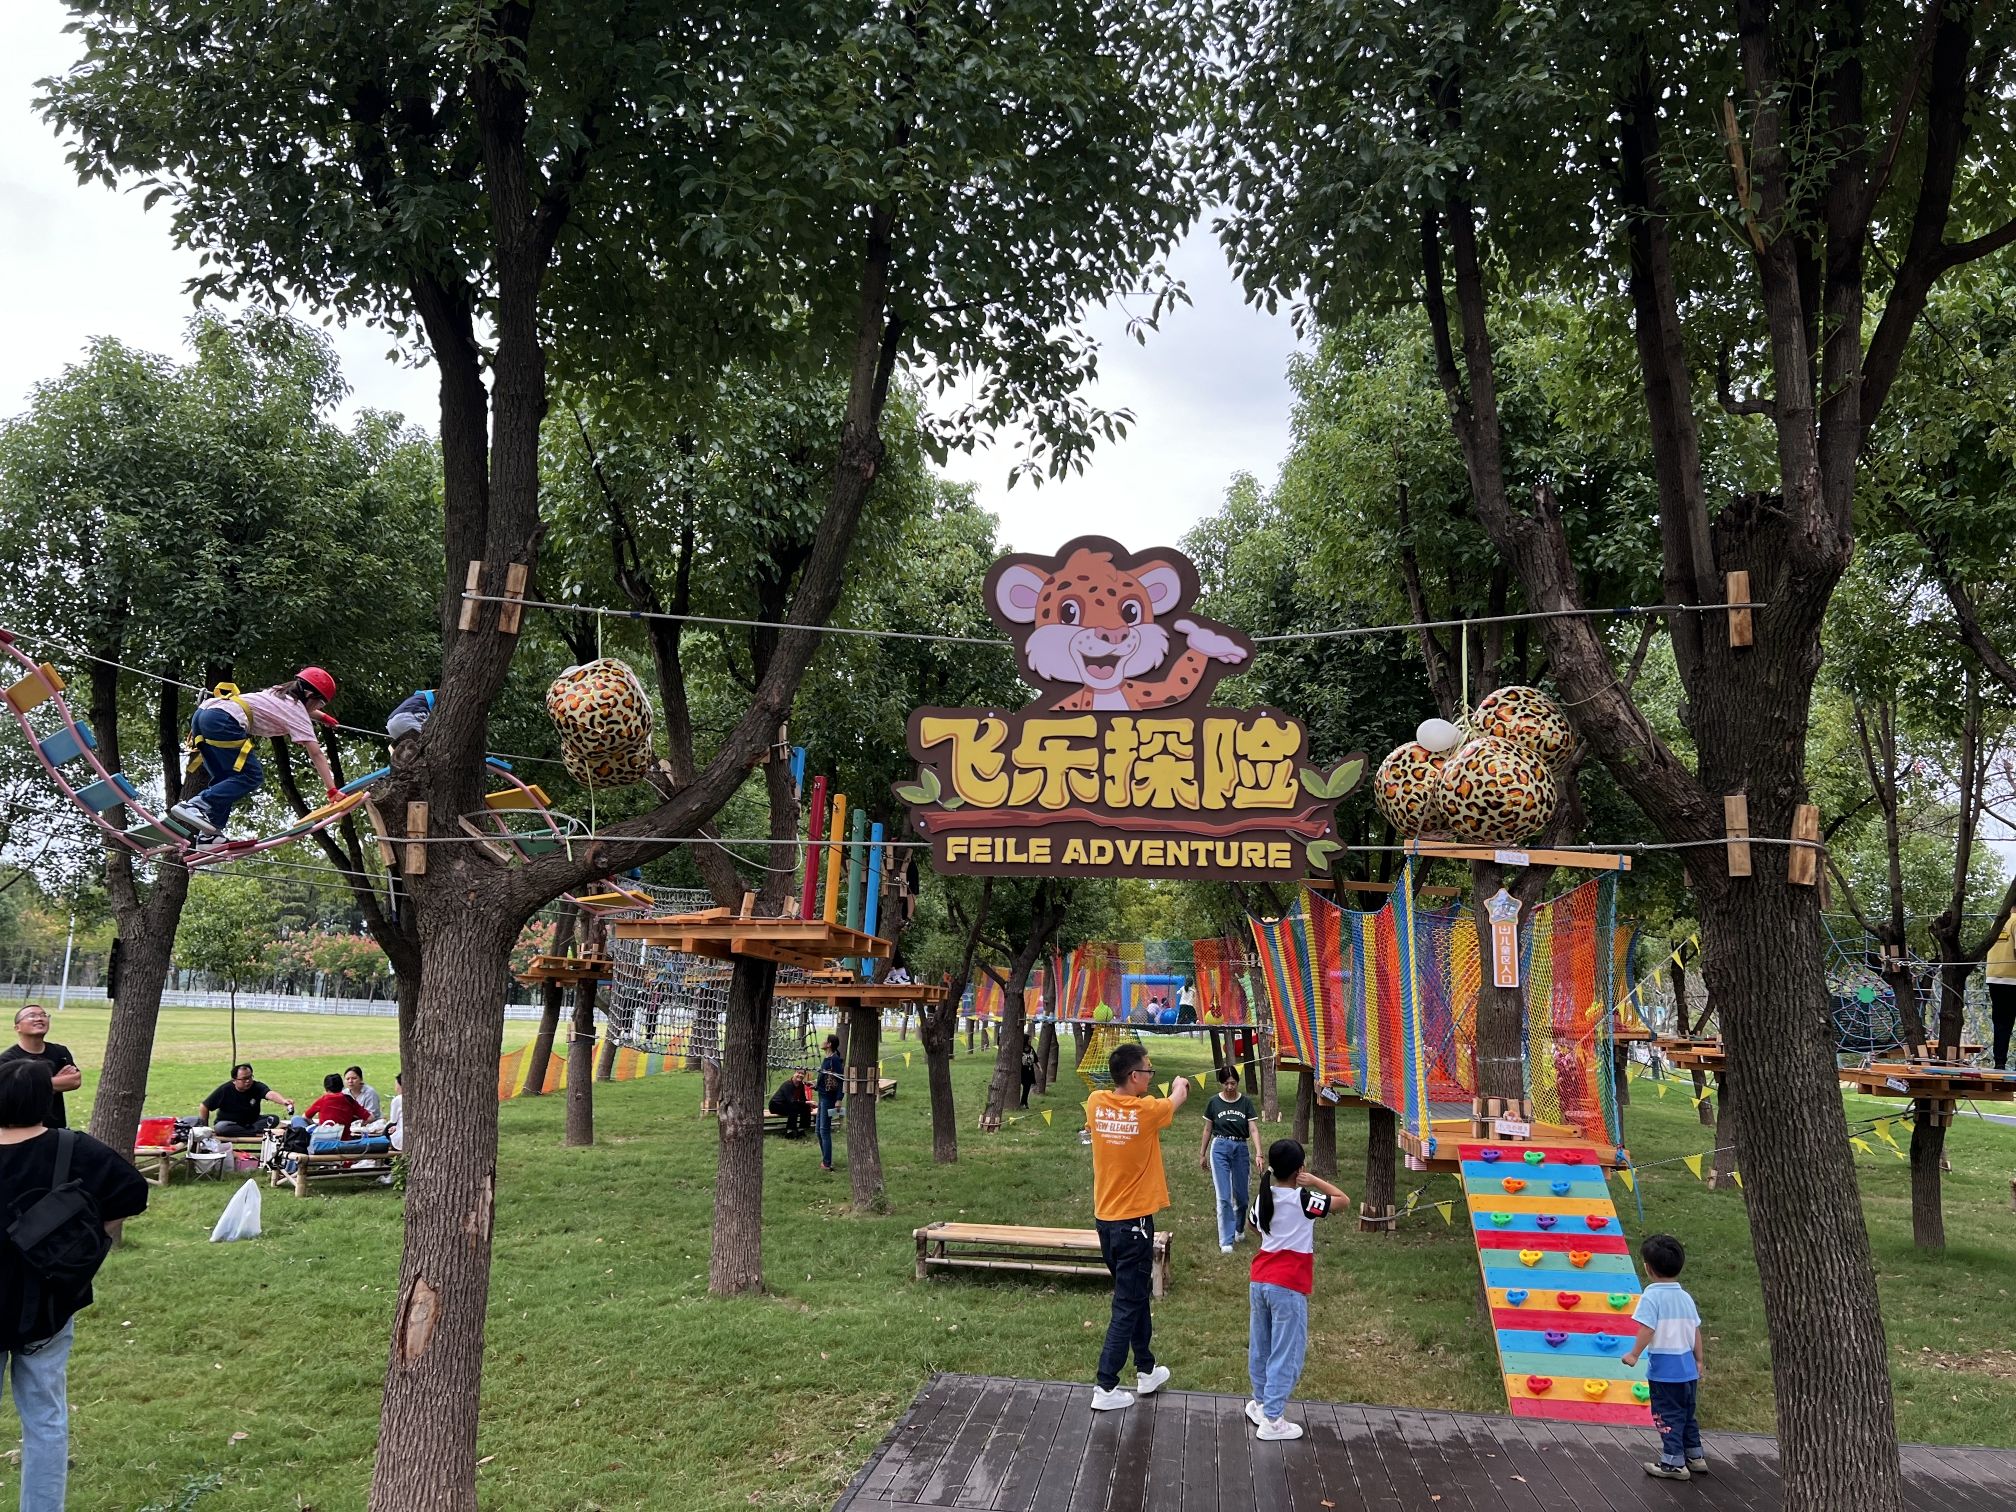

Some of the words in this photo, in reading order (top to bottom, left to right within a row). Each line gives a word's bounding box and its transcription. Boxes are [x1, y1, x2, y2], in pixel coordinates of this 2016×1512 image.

[920, 716, 1301, 810] 飞乐探险
[946, 837, 1053, 865] FEILE
[1061, 838, 1293, 869] ADVENTURE
